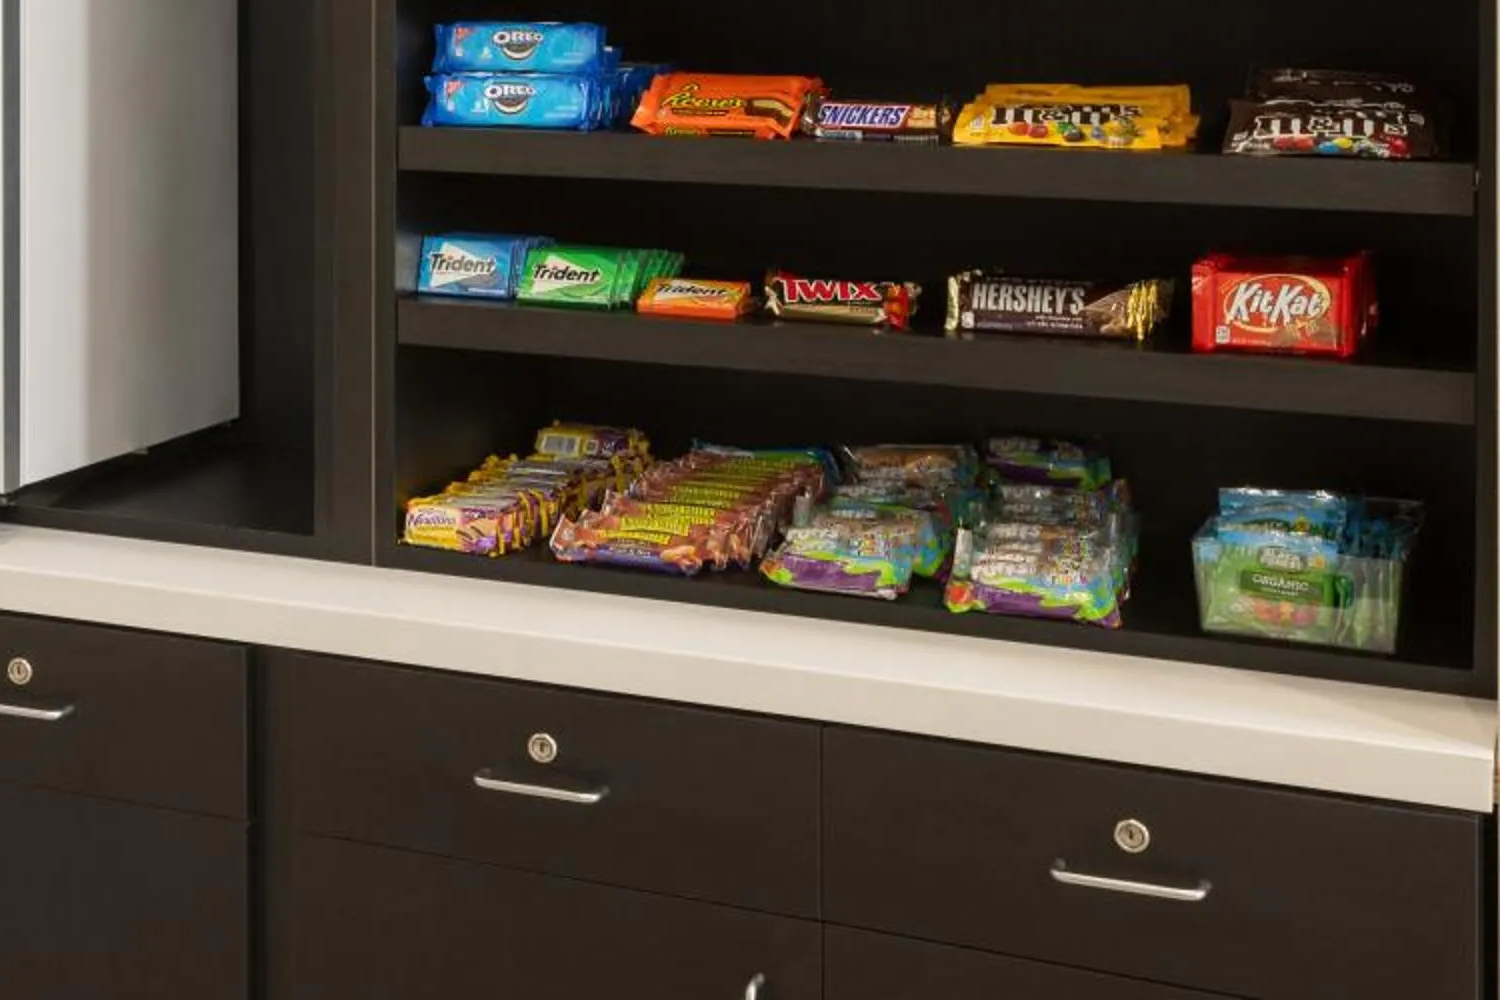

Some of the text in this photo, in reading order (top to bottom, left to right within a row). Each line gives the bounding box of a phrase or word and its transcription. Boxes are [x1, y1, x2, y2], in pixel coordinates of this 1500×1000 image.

[492, 30, 544, 44] OREO
[485, 83, 536, 98] OREO
[819, 104, 906, 126] SNICKERS
[430, 253, 496, 274] Trident
[532, 265, 601, 283] Trident
[657, 283, 727, 296] Trident
[773, 277, 883, 303] TWIX
[971, 283, 1086, 315] HERSHEY'S
